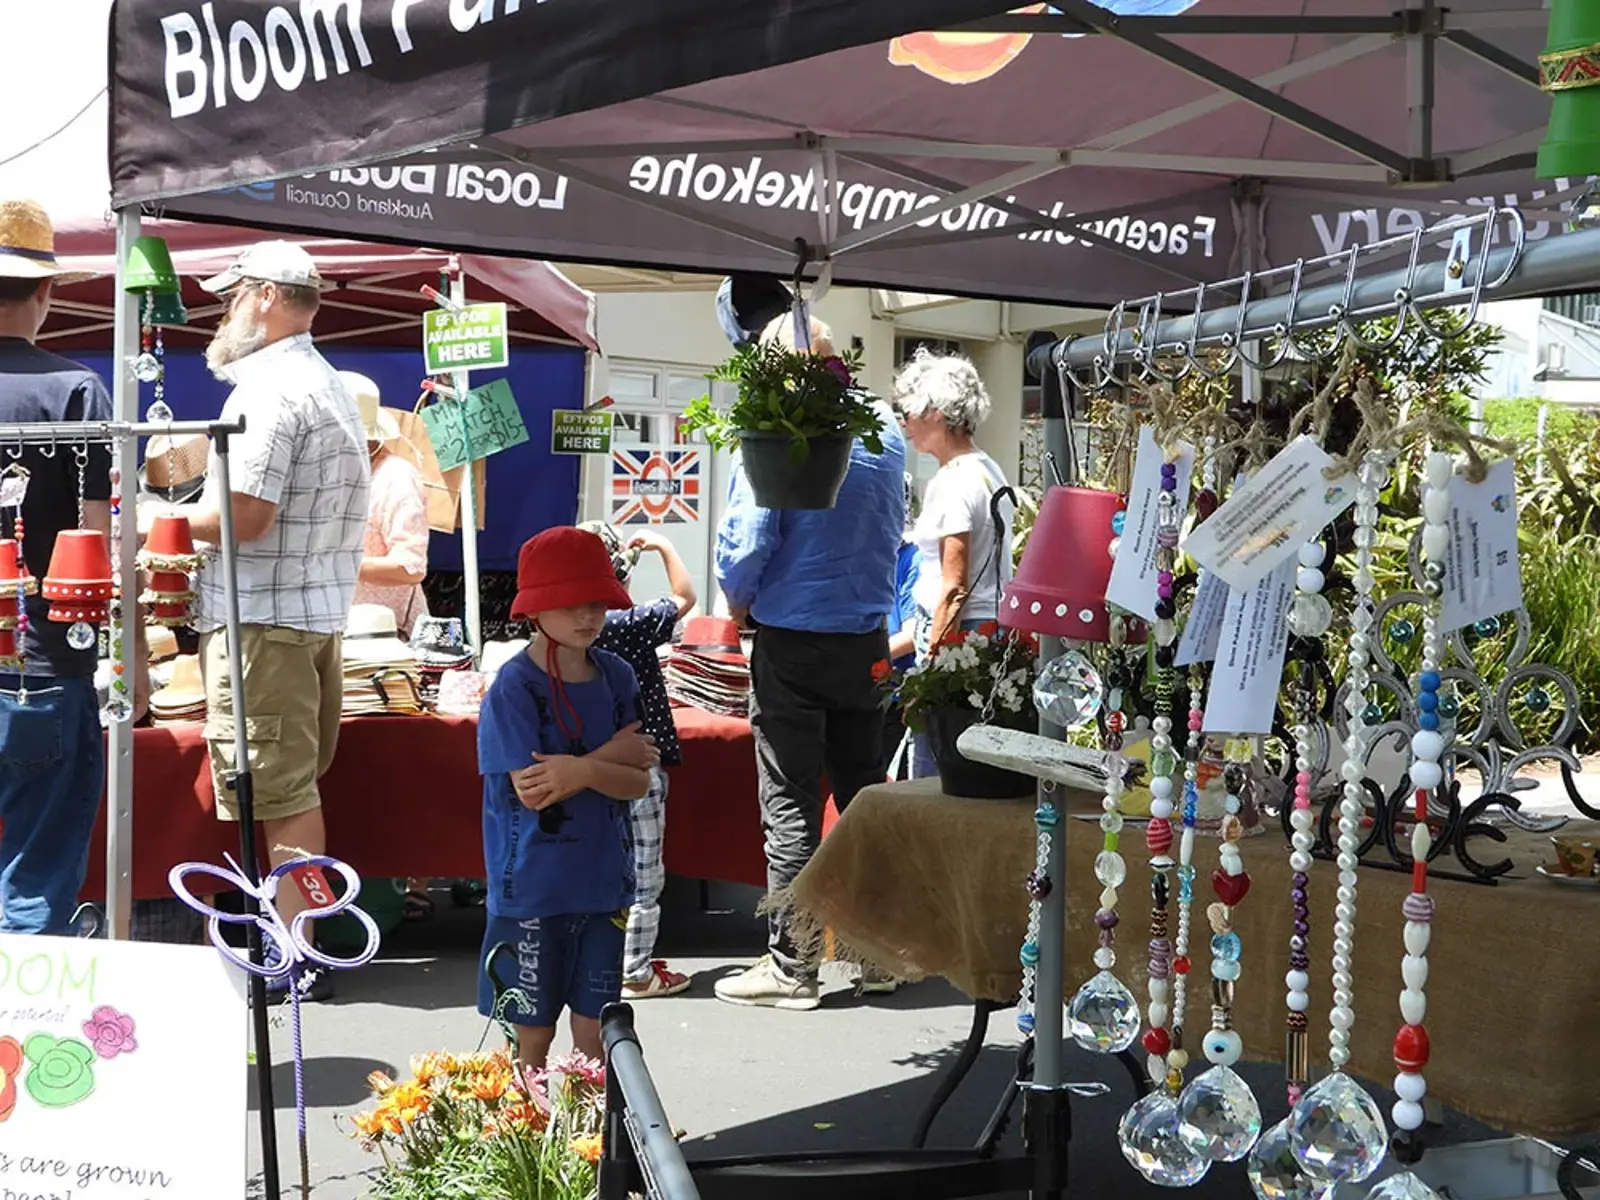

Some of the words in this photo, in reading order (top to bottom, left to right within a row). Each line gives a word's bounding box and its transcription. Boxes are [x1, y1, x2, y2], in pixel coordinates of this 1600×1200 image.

[160, 0, 372, 118] Bloom
[428, 325, 502, 344] AVAILABLE
[438, 341, 492, 362] HERE
[555, 425, 610, 436] AVAILABLE
[451, 438, 467, 463] 2
[563, 436, 602, 449] HERE
[20, 1156, 71, 1178] are
[76, 1161, 172, 1189] grown
